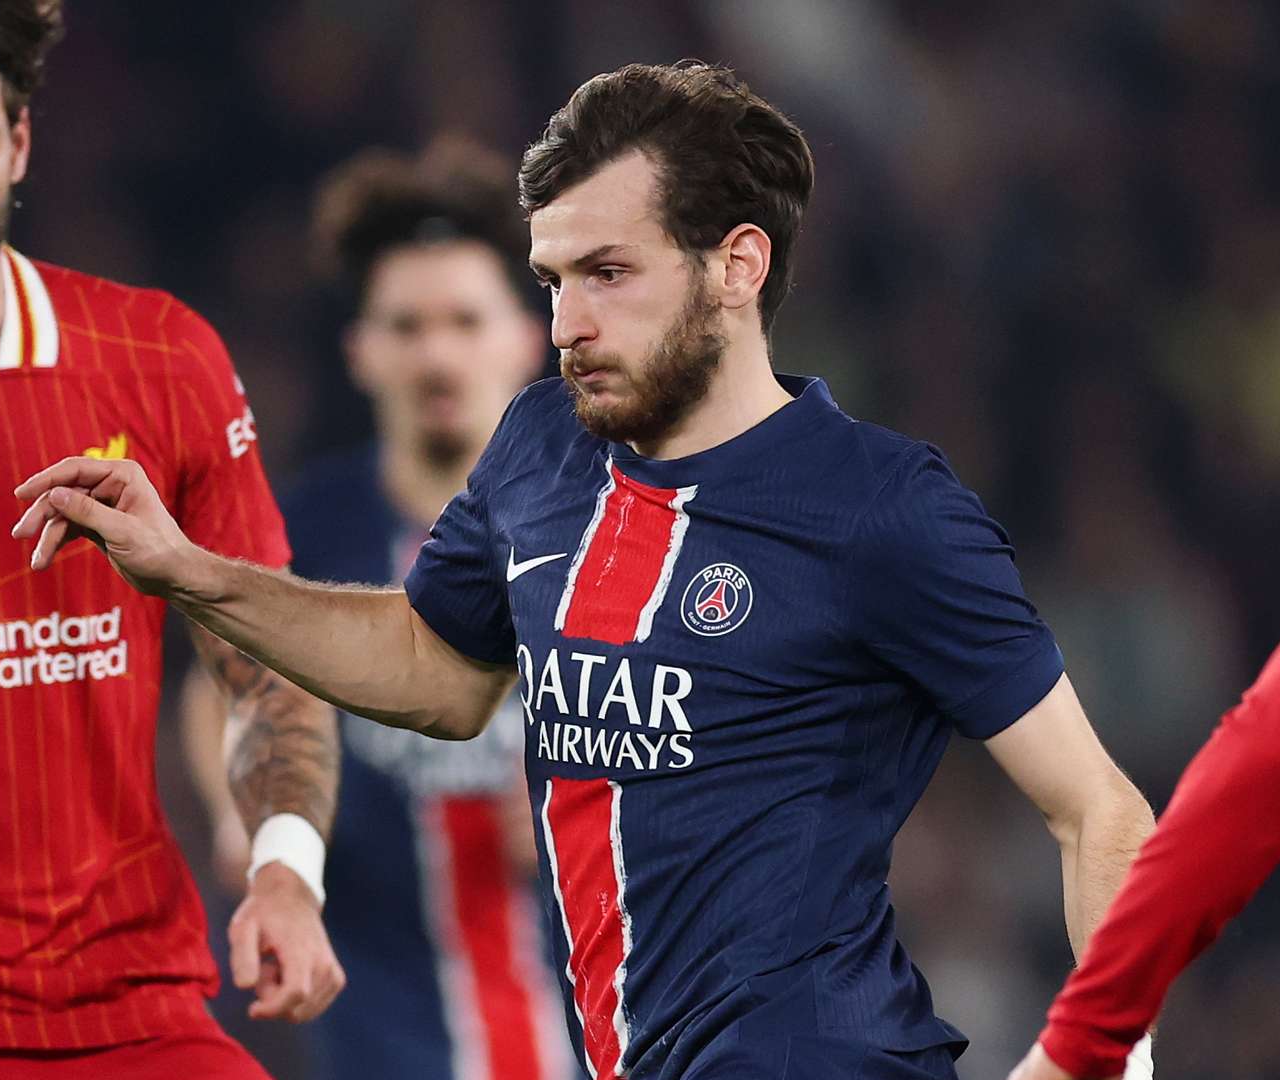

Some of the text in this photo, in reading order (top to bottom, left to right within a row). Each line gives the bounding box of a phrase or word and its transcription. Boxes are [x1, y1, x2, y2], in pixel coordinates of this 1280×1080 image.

[702, 566, 746, 590] PARIS
[517, 643, 693, 732] QATAR
[538, 721, 694, 770] AIRWAYS
